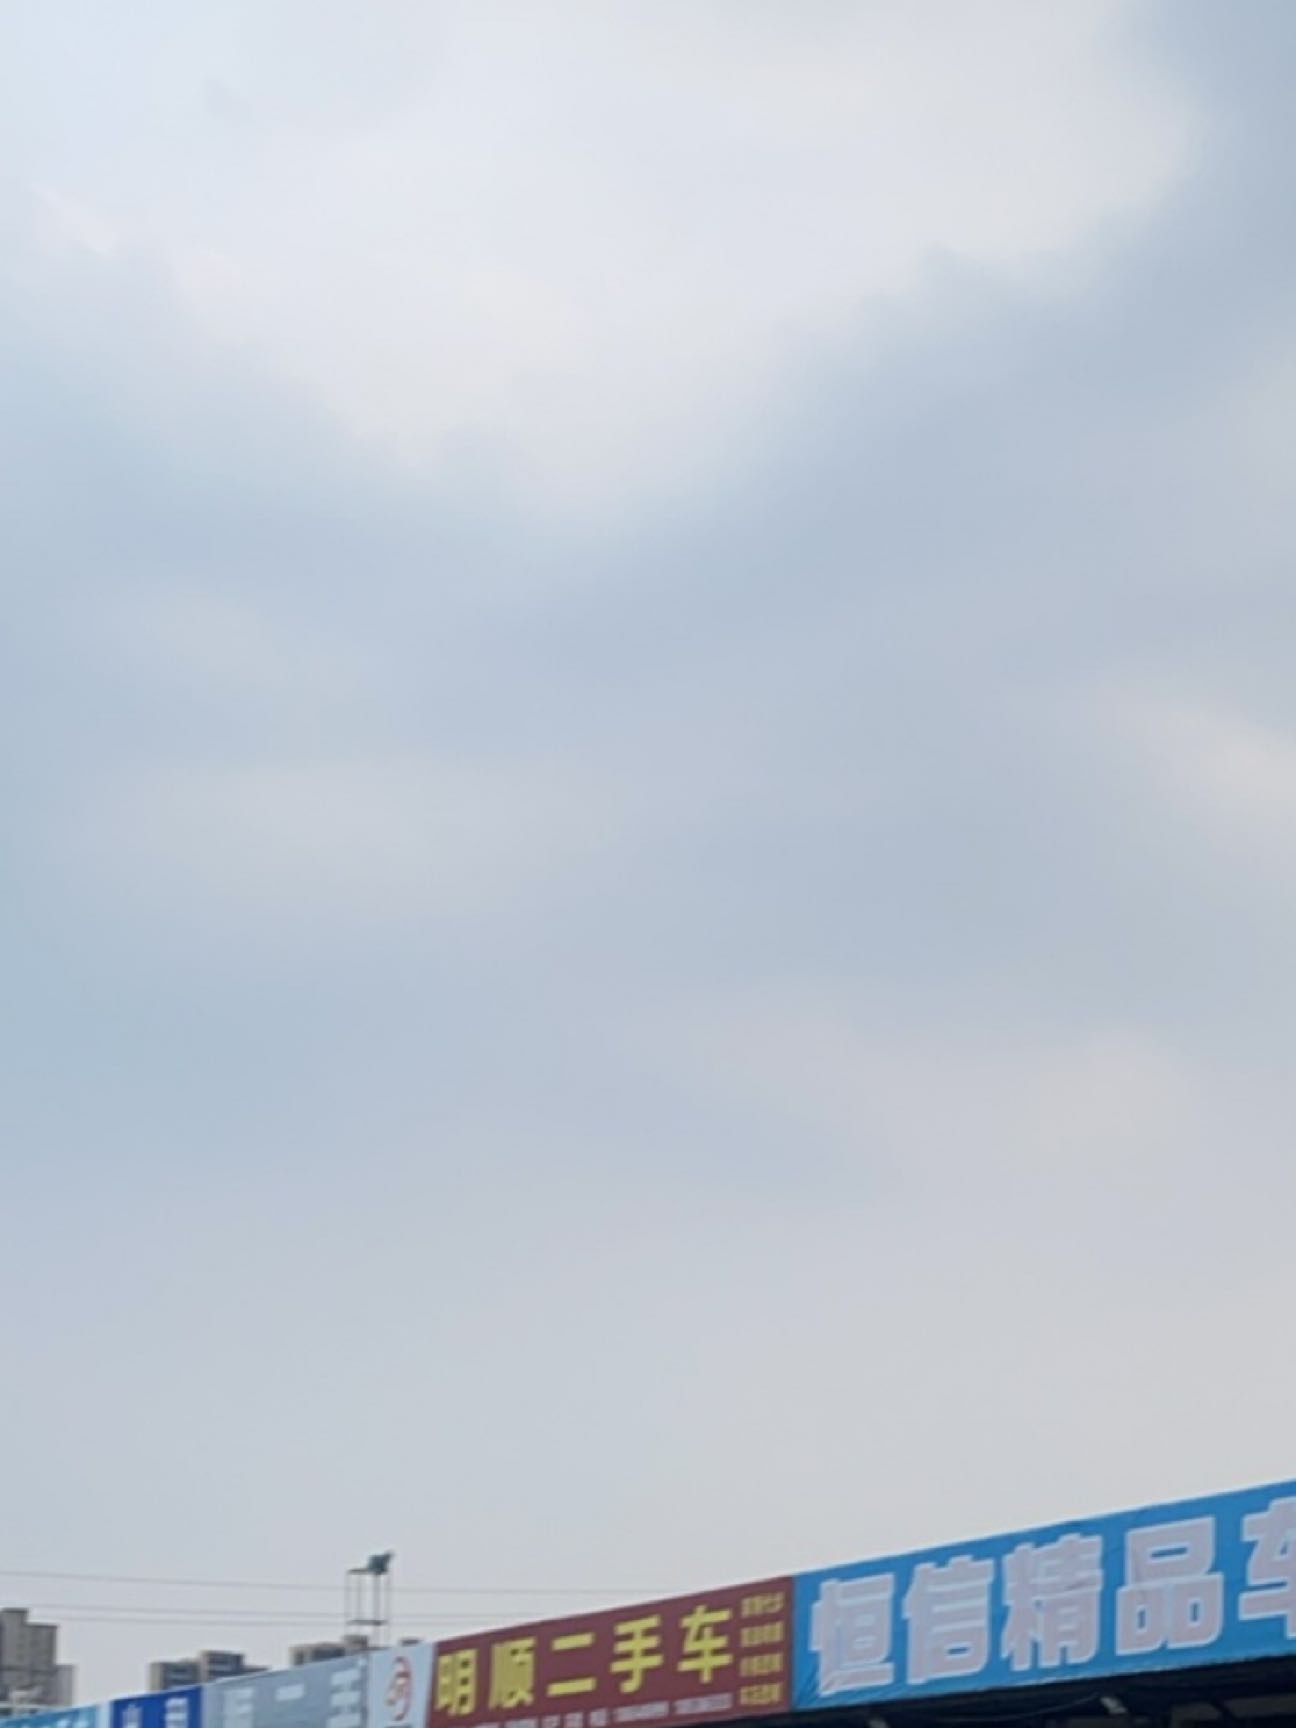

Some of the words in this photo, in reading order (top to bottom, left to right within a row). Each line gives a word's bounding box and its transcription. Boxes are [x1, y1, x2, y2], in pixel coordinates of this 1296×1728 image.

[434, 1604, 733, 1716] 明顺二手车
